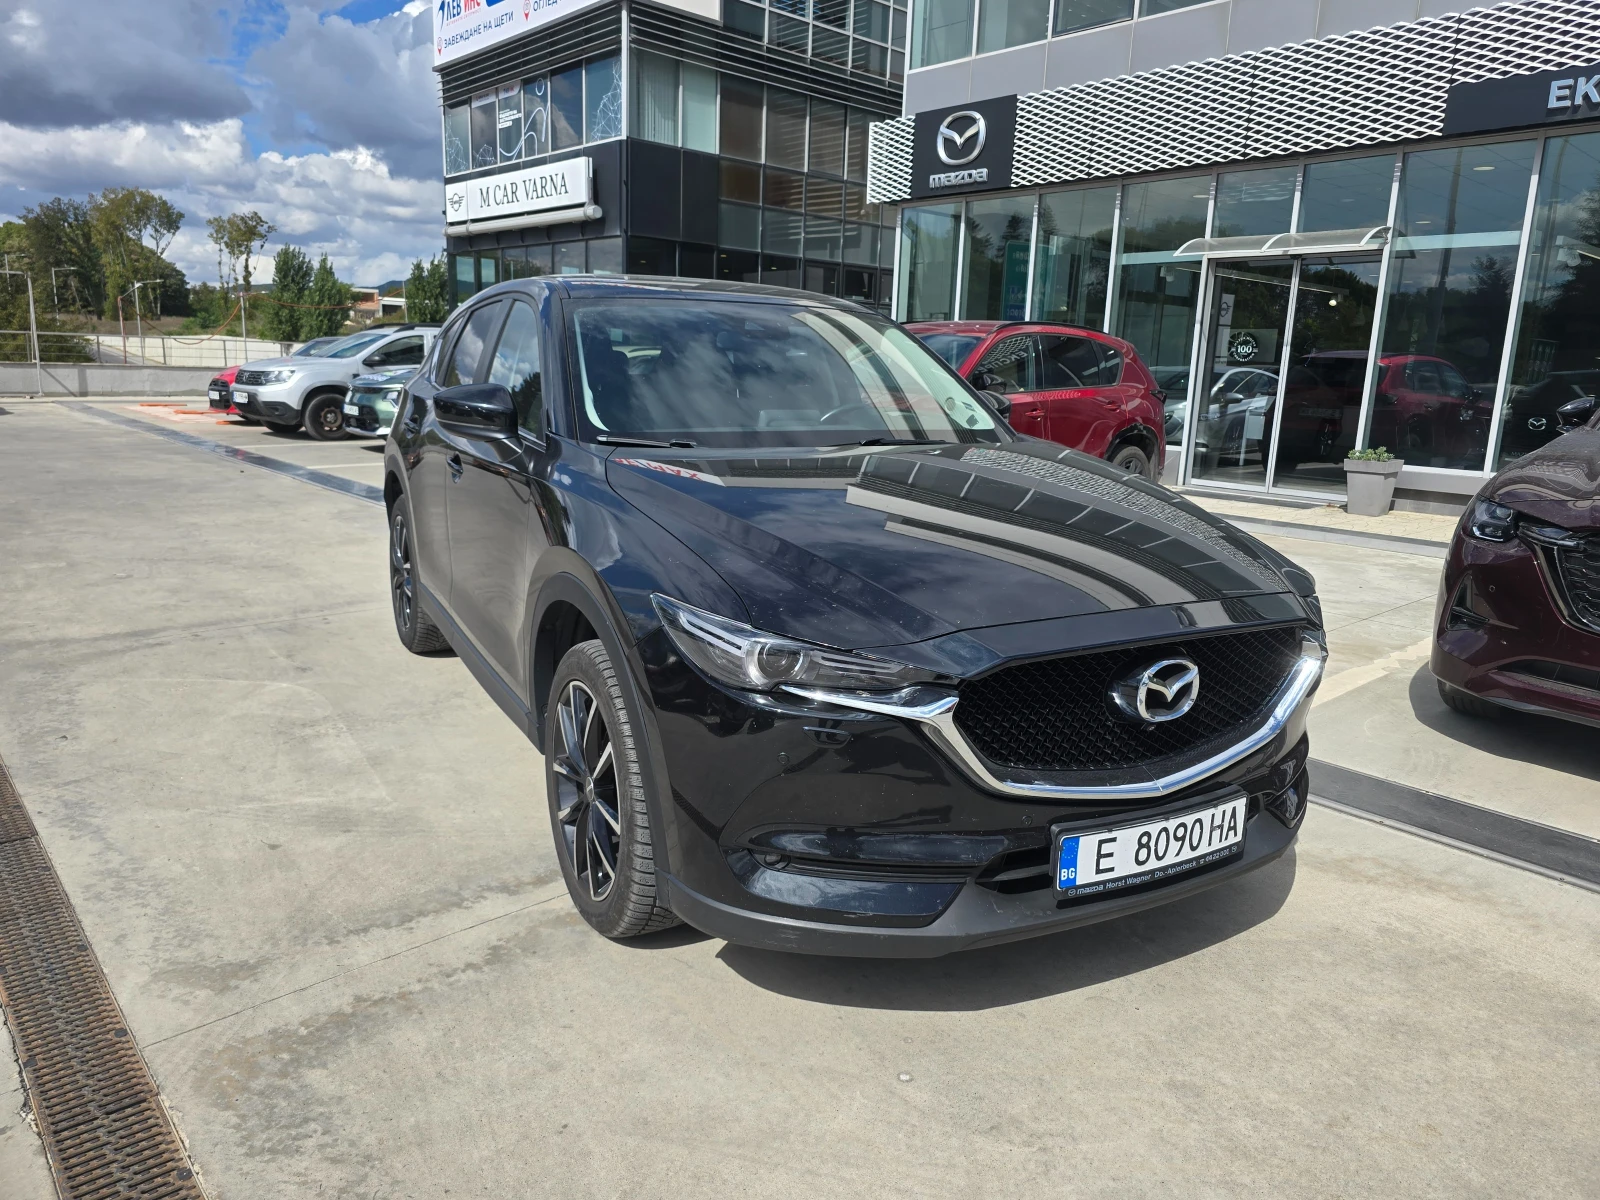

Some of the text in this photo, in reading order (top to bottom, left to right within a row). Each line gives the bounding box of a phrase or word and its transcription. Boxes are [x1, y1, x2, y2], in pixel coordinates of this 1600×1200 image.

[444, 24, 482, 49] ЗАВЕЖДАНЕ
[483, 21, 493, 33] НА
[494, 11, 514, 28] ЩЕТИ
[929, 168, 988, 189] mazda
[479, 172, 569, 208] M CAR VARNA
[1237, 344, 1252, 353] 100
[1095, 805, 1238, 875] E 8090 HA
[1060, 867, 1076, 880] BG
[1106, 880, 1125, 890] Horst
[1126, 873, 1152, 886] Wagner
